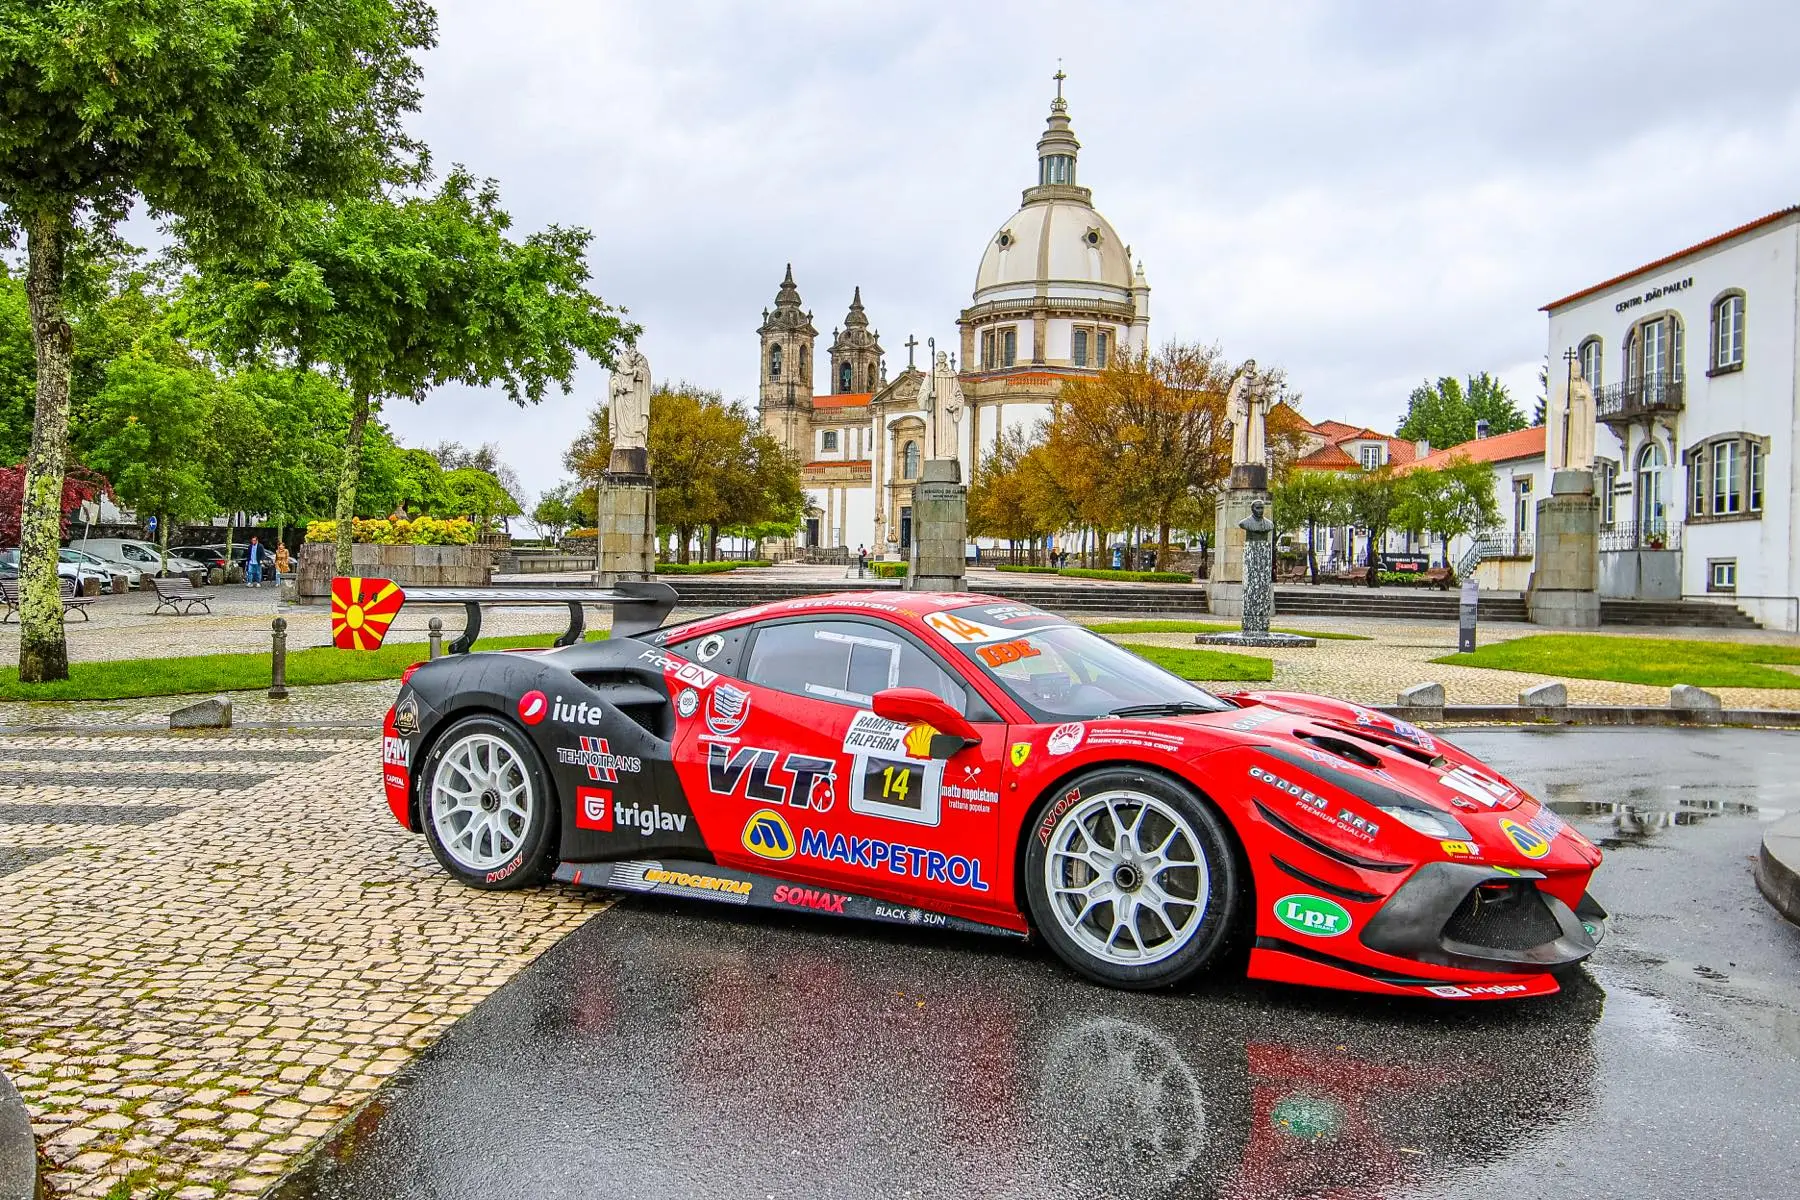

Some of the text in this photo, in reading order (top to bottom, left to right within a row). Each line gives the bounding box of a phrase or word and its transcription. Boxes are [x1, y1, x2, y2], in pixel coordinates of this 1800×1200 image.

[1615, 296, 1642, 313] CENTRO
[1643, 287, 1662, 303] JOÃO
[931, 614, 989, 641] 14
[552, 695, 603, 725] iute
[856, 716, 895, 731] RAMPA
[846, 732, 900, 751] FALPERRA
[557, 748, 641, 773] TEHNOTRANS
[883, 765, 911, 801] 14
[942, 784, 999, 803] matto napoletano
[1248, 766, 1379, 835] GOLDEN ART
[614, 802, 687, 836] triglav
[1037, 788, 1081, 848] AVON
[1296, 801, 1375, 844] PREMIUM QUALITY
[486, 850, 523, 883] AVON
[800, 828, 989, 891] MAKPETROL
[644, 869, 752, 895] MOTOCENTAR
[875, 906, 946, 925] BLACK SUN
[1286, 902, 1339, 928] Lpr
